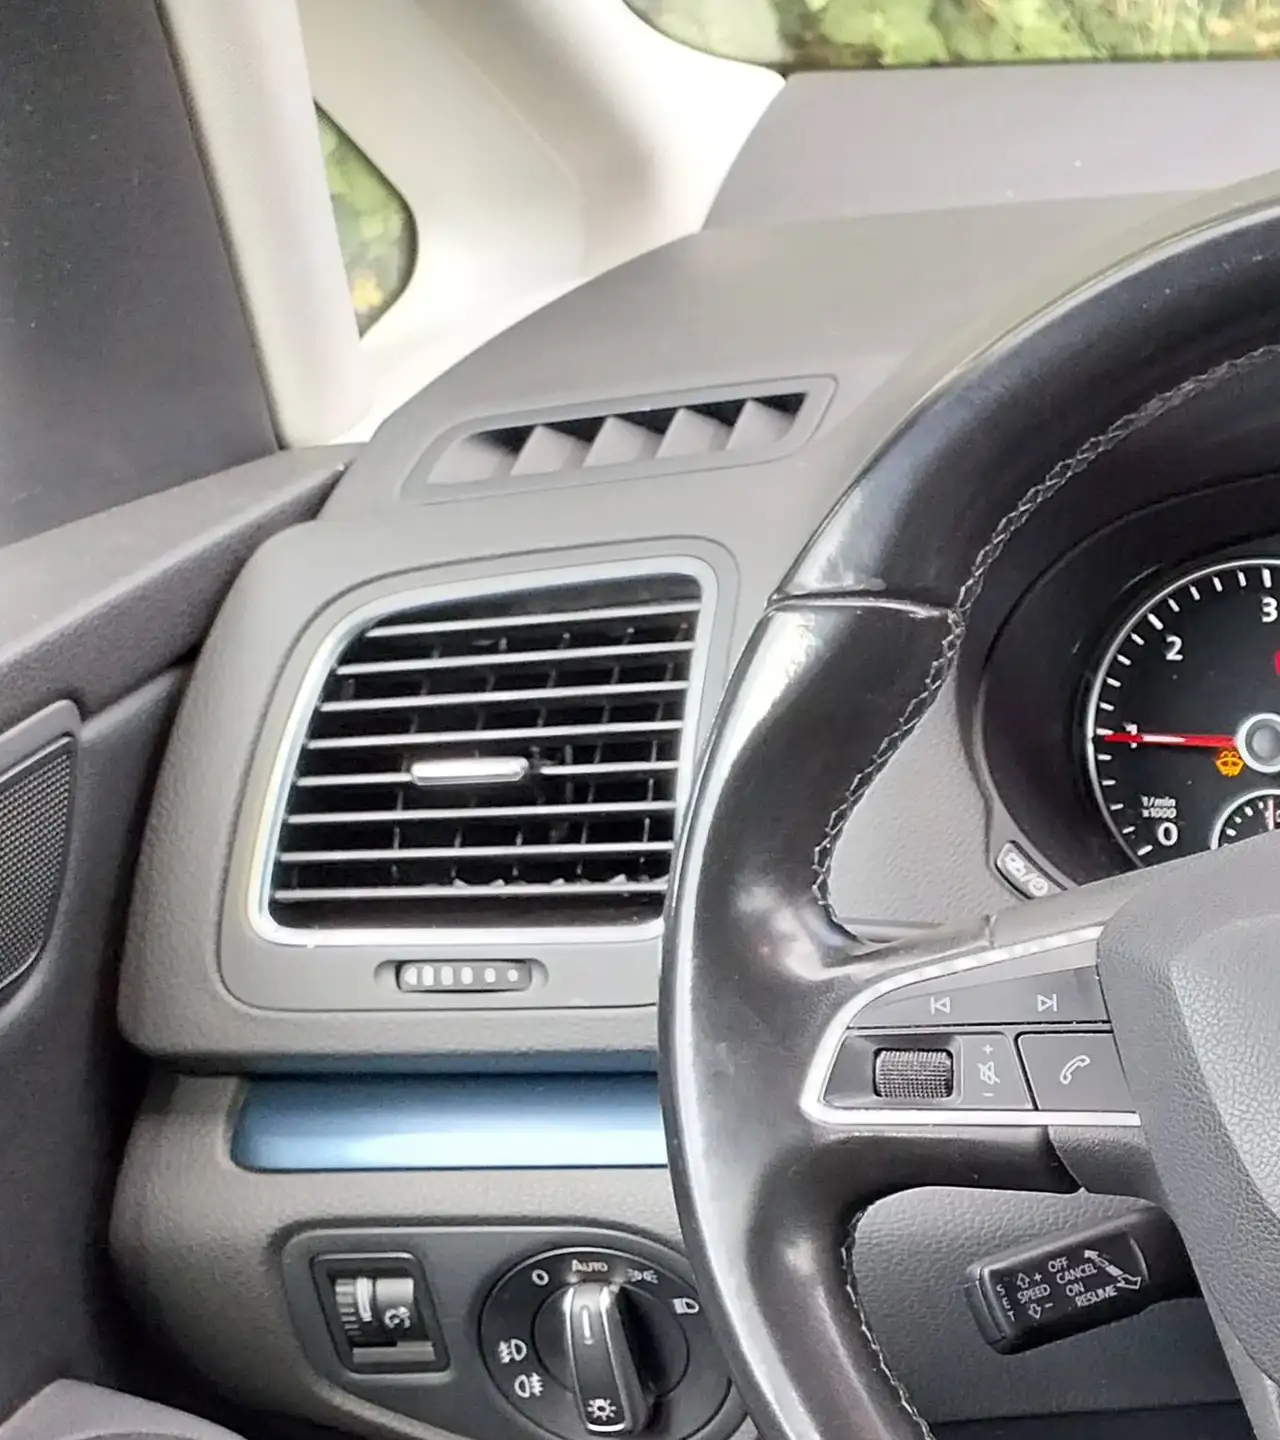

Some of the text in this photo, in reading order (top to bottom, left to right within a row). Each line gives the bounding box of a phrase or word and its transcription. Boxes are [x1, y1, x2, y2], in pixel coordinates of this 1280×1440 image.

[1261, 597, 1279, 622] 3
[1165, 637, 1184, 662] 2
[1157, 822, 1179, 846] 0
[1048, 1256, 1069, 1273] OFF
[1056, 1262, 1098, 1285] CANCEL
[1017, 1284, 1051, 1304] SPEED
[1066, 1281, 1085, 1297] ON
[1075, 1284, 1118, 1308] RESUME
